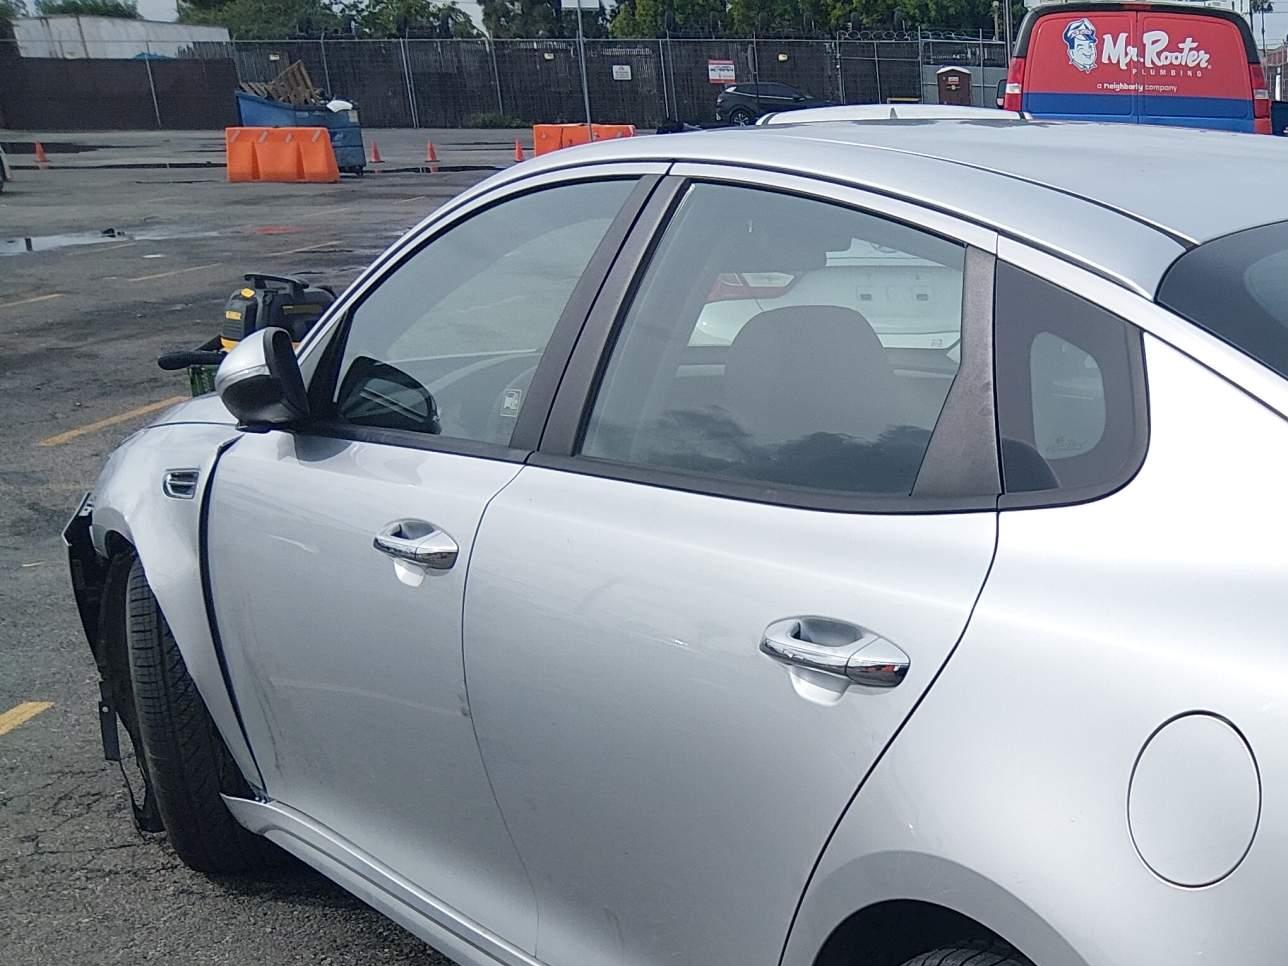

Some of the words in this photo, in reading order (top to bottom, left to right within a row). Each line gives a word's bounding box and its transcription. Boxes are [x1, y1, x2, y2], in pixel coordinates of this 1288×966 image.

[1101, 32, 1143, 70] Mr.
[1143, 30, 1210, 69] Rooter
[1131, 68, 1202, 78] PLUMBING
[1103, 81, 1144, 92] neighborly
[1145, 84, 1177, 93] company
